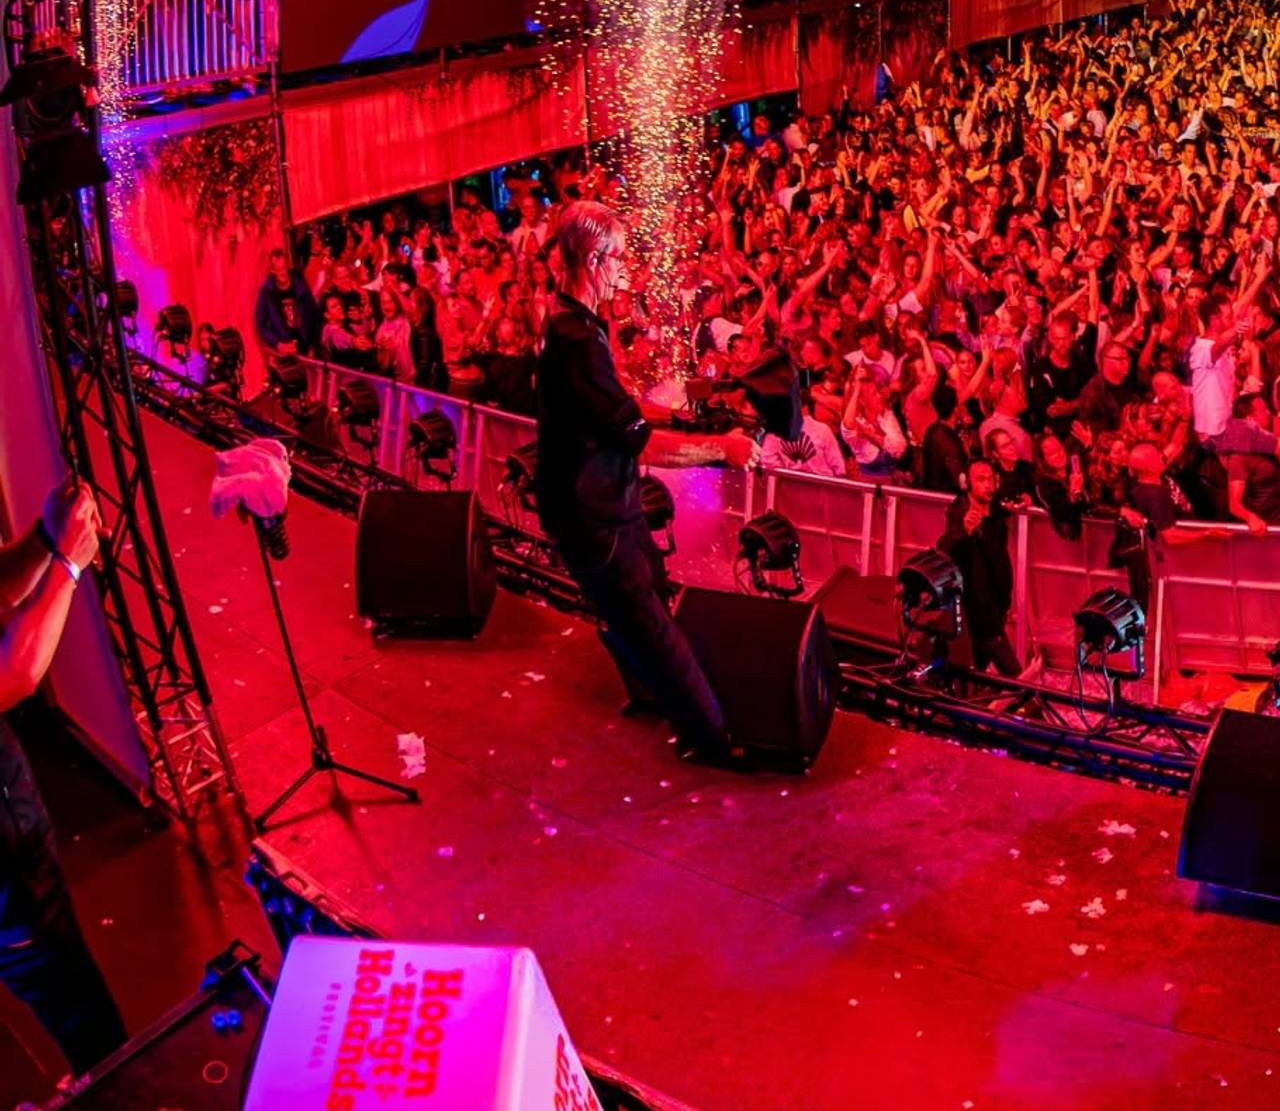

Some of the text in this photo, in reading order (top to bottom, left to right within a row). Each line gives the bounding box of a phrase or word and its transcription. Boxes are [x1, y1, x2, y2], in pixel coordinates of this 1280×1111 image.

[326, 949, 395, 1111] Hollands
[367, 982, 416, 1078] zingt
[404, 969, 464, 1097] Hoorn
